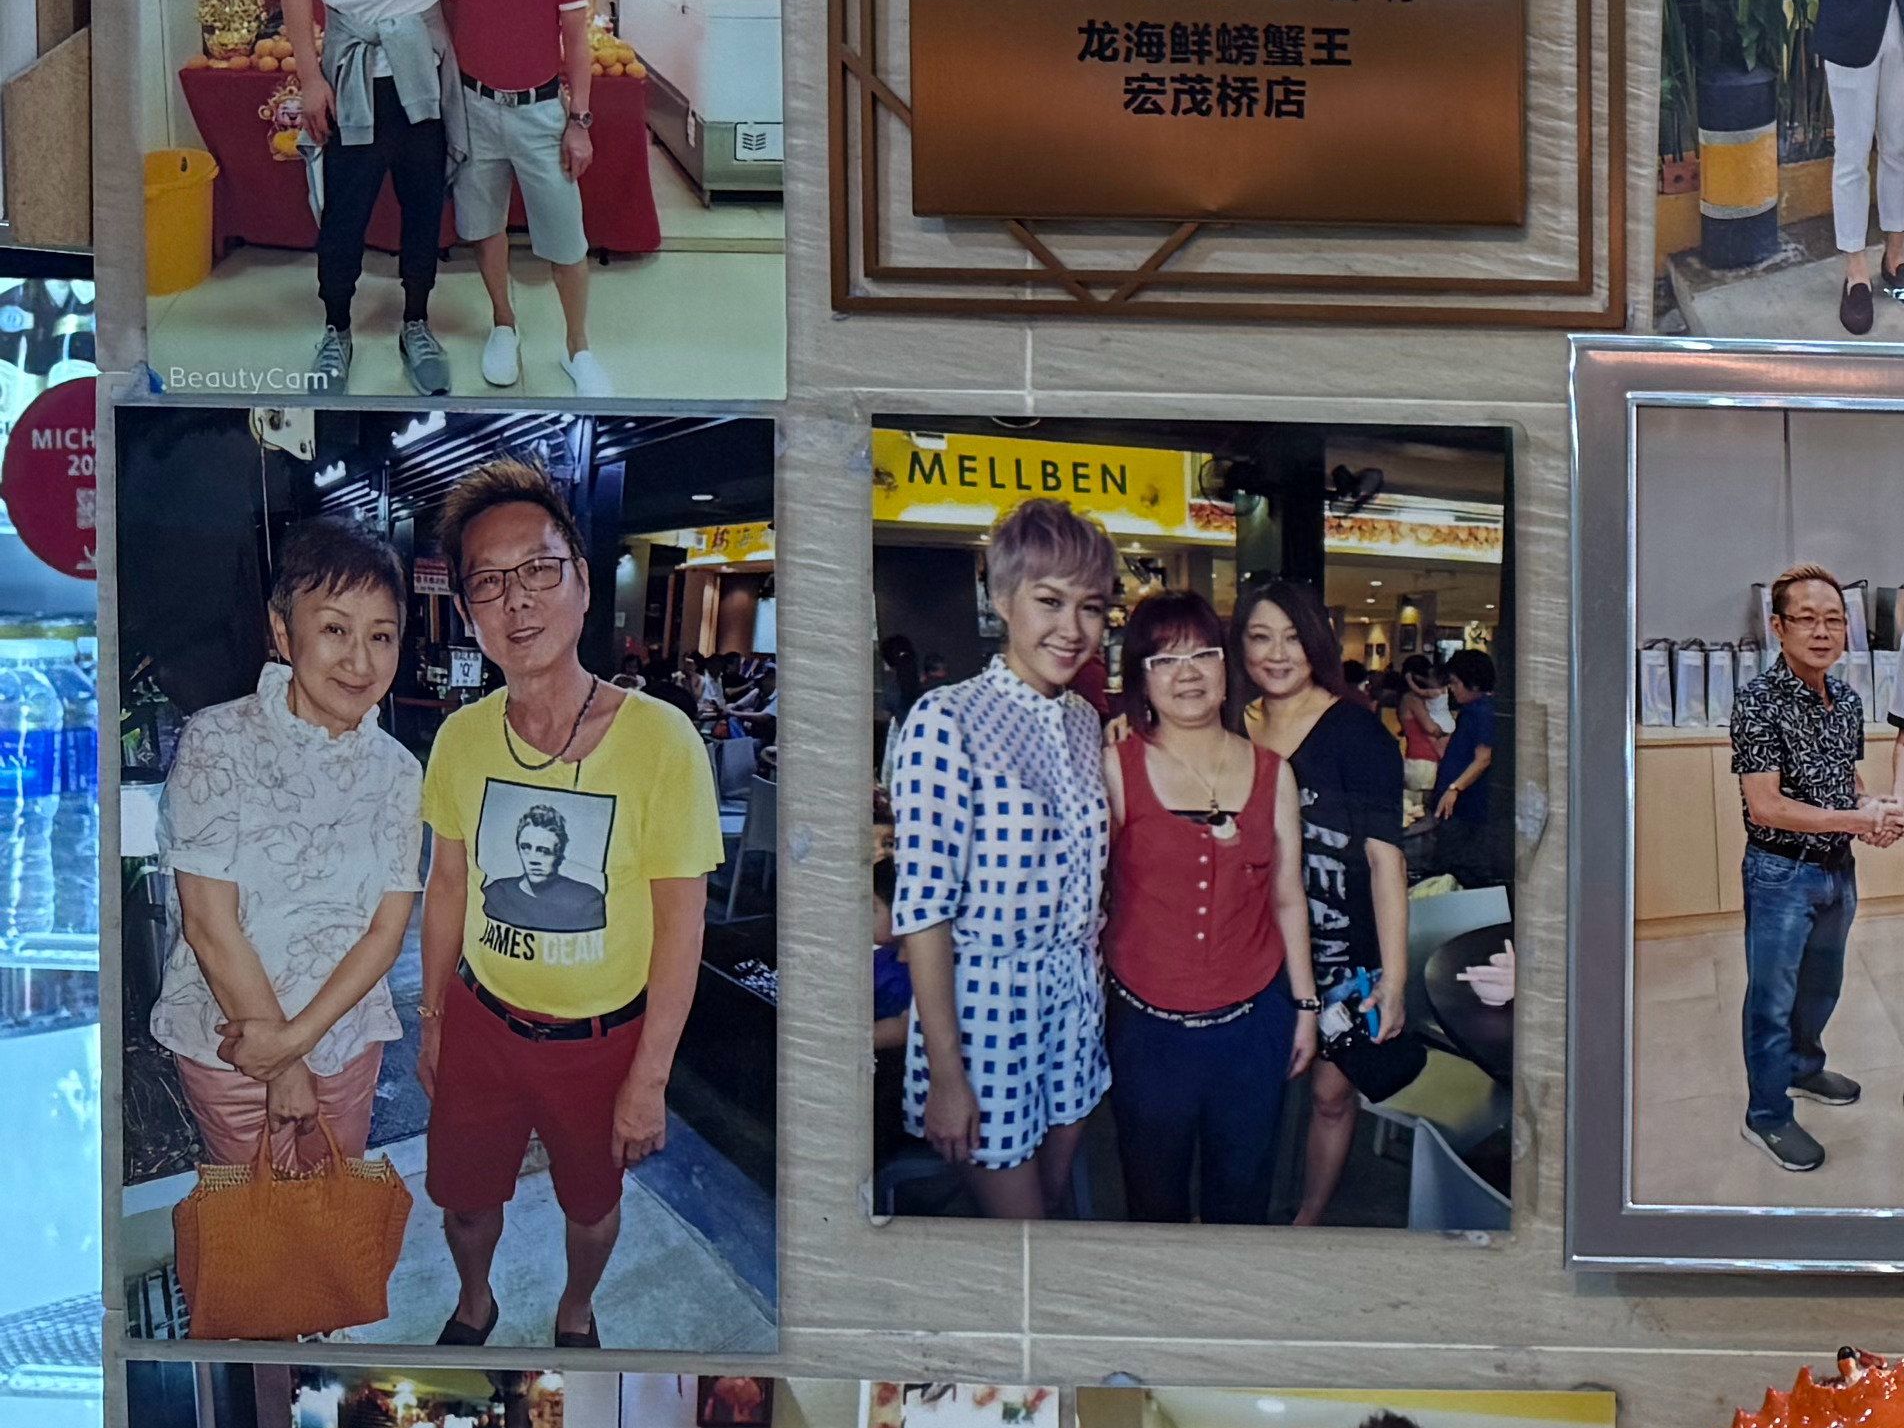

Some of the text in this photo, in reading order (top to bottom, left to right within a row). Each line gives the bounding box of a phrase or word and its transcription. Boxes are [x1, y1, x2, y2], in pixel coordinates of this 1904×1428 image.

[1076, 20, 1353, 67] 龙海鲜螃蟹王
[1122, 73, 1307, 121] 宏茂桥店
[170, 366, 329, 394] BeautyCam
[907, 451, 1130, 496] MELLBEN
[478, 924, 536, 963] JAMES
